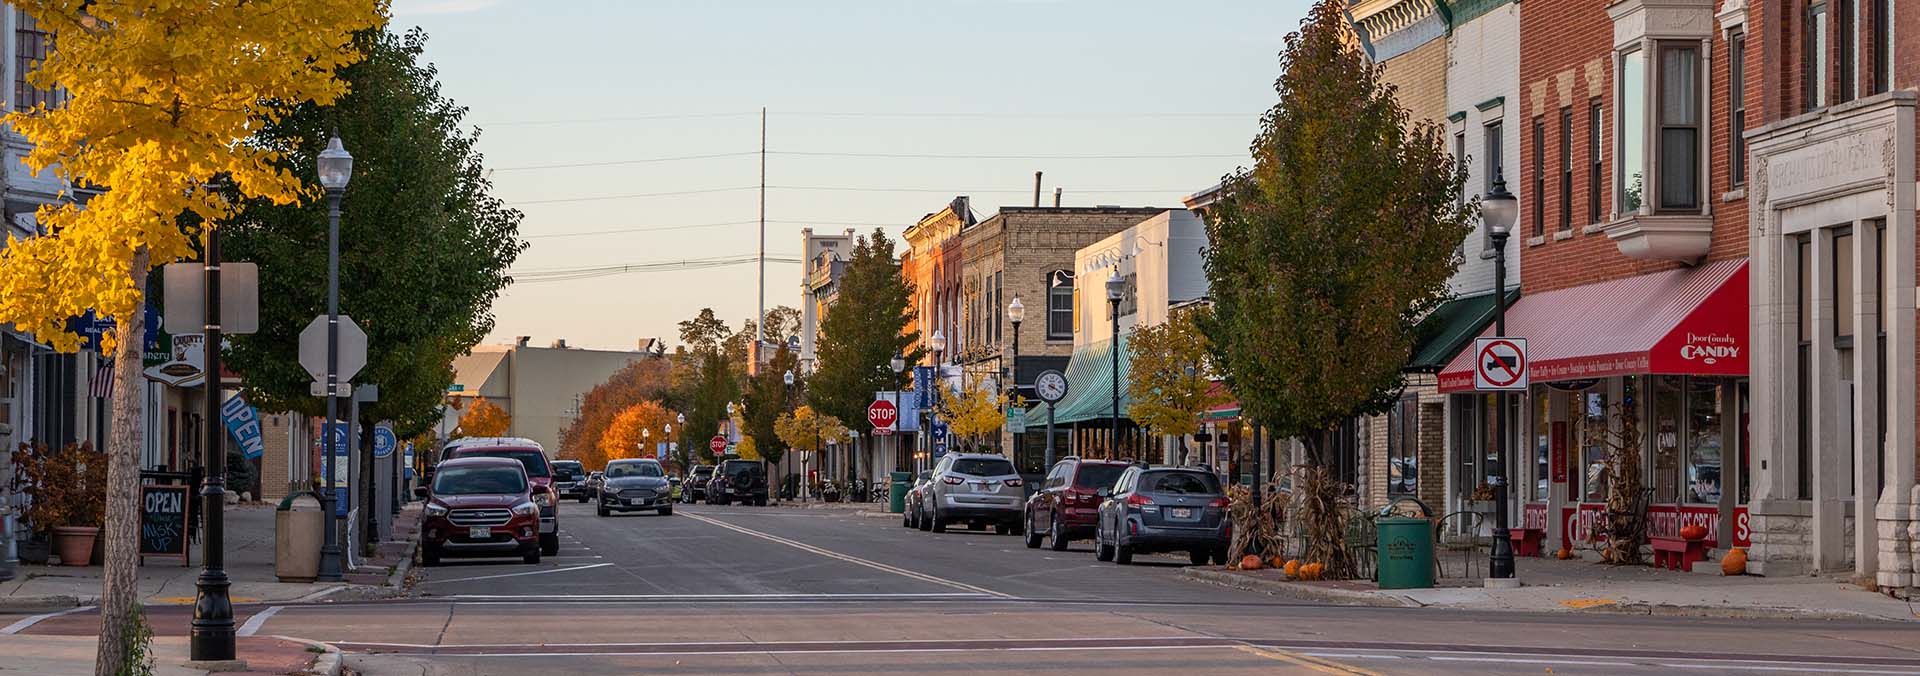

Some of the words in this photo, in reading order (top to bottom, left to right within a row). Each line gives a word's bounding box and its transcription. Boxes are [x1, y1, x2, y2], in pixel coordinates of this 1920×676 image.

[1687, 332, 1708, 345] Door
[1708, 333, 1735, 345] County
[1680, 345, 1740, 360] CANDY
[870, 408, 896, 420] STOP
[222, 396, 264, 454] OPEN
[144, 492, 182, 513] OPEN
[151, 537, 172, 551] UP
